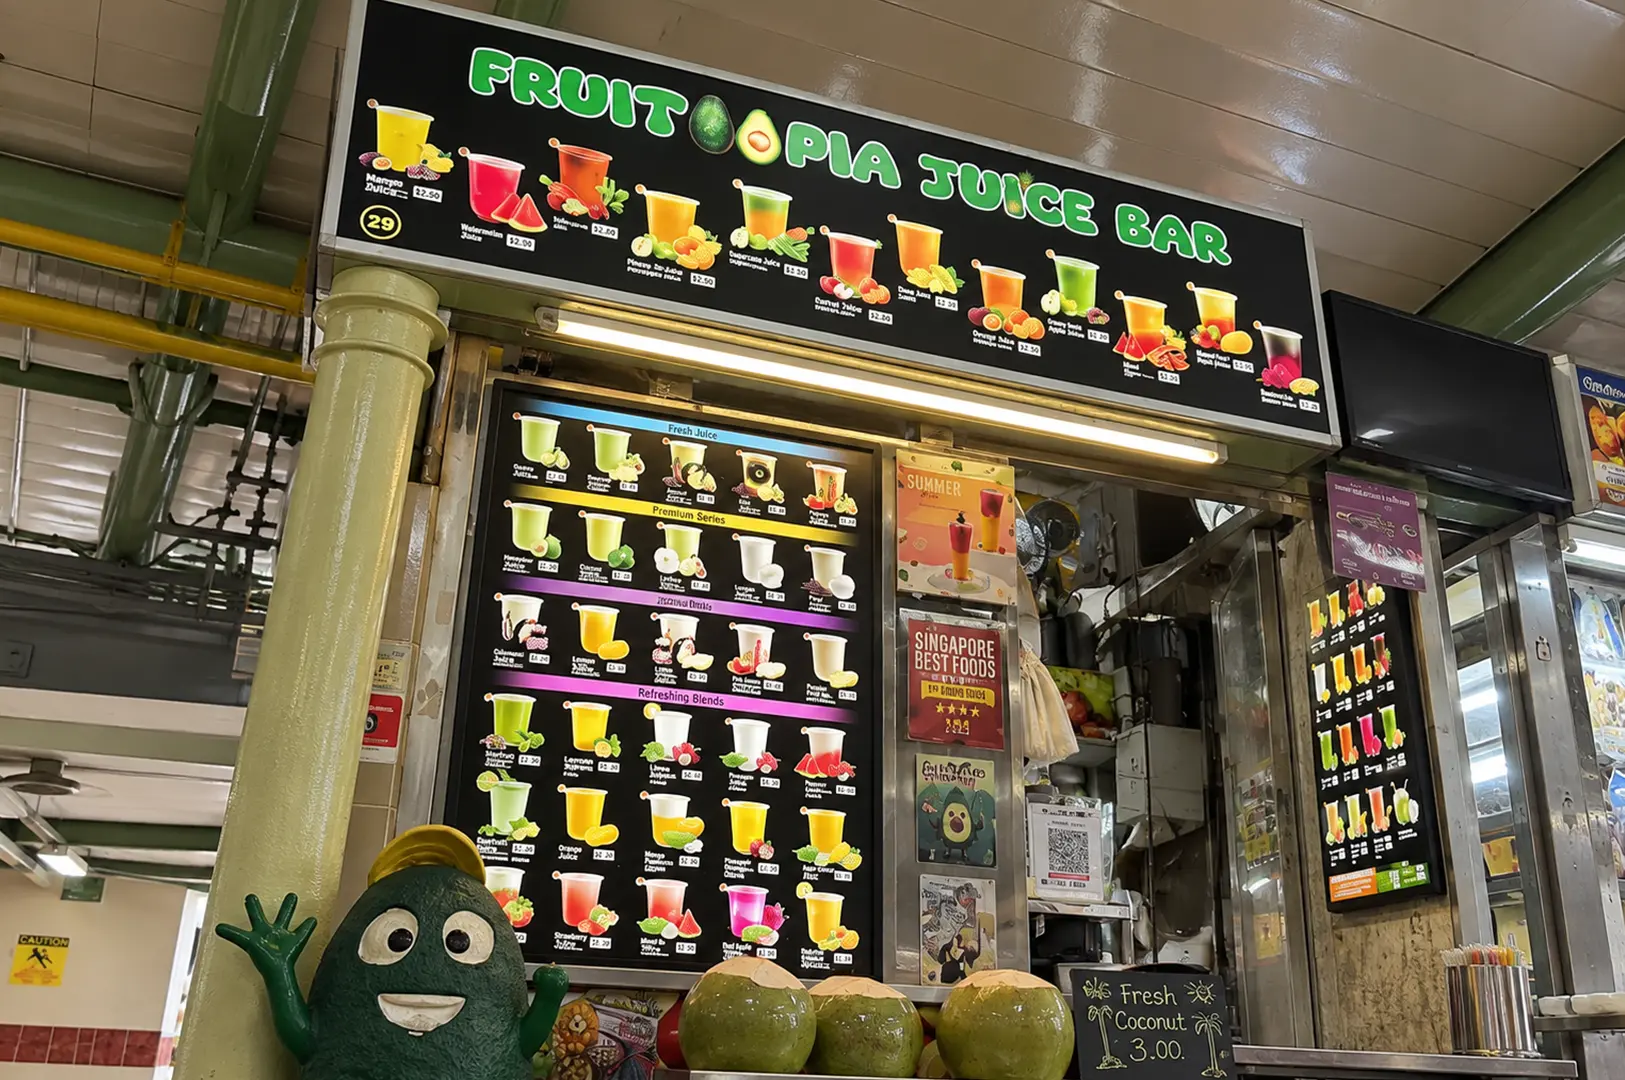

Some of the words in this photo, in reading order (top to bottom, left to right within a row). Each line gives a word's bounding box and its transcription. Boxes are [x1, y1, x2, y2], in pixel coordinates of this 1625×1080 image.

[785, 121, 901, 188] PIA
[918, 153, 1098, 237] JUICE
[1115, 204, 1231, 266] BAR
[367, 214, 395, 231] 29
[668, 424, 693, 436] Fresh
[694, 428, 718, 441] Juice
[907, 474, 962, 497] SUMMER
[652, 505, 694, 520] Premium
[696, 513, 726, 525] Series
[915, 631, 995, 659] SINGAPORE
[915, 650, 949, 672] BEST
[952, 655, 996, 679] FOODS
[638, 687, 690, 704] Refreshing
[692, 694, 725, 706] Blends
[20, 935, 69, 947] CAUTION
[1120, 983, 1178, 1006] Fresh
[1115, 1010, 1187, 1031] Coconut
